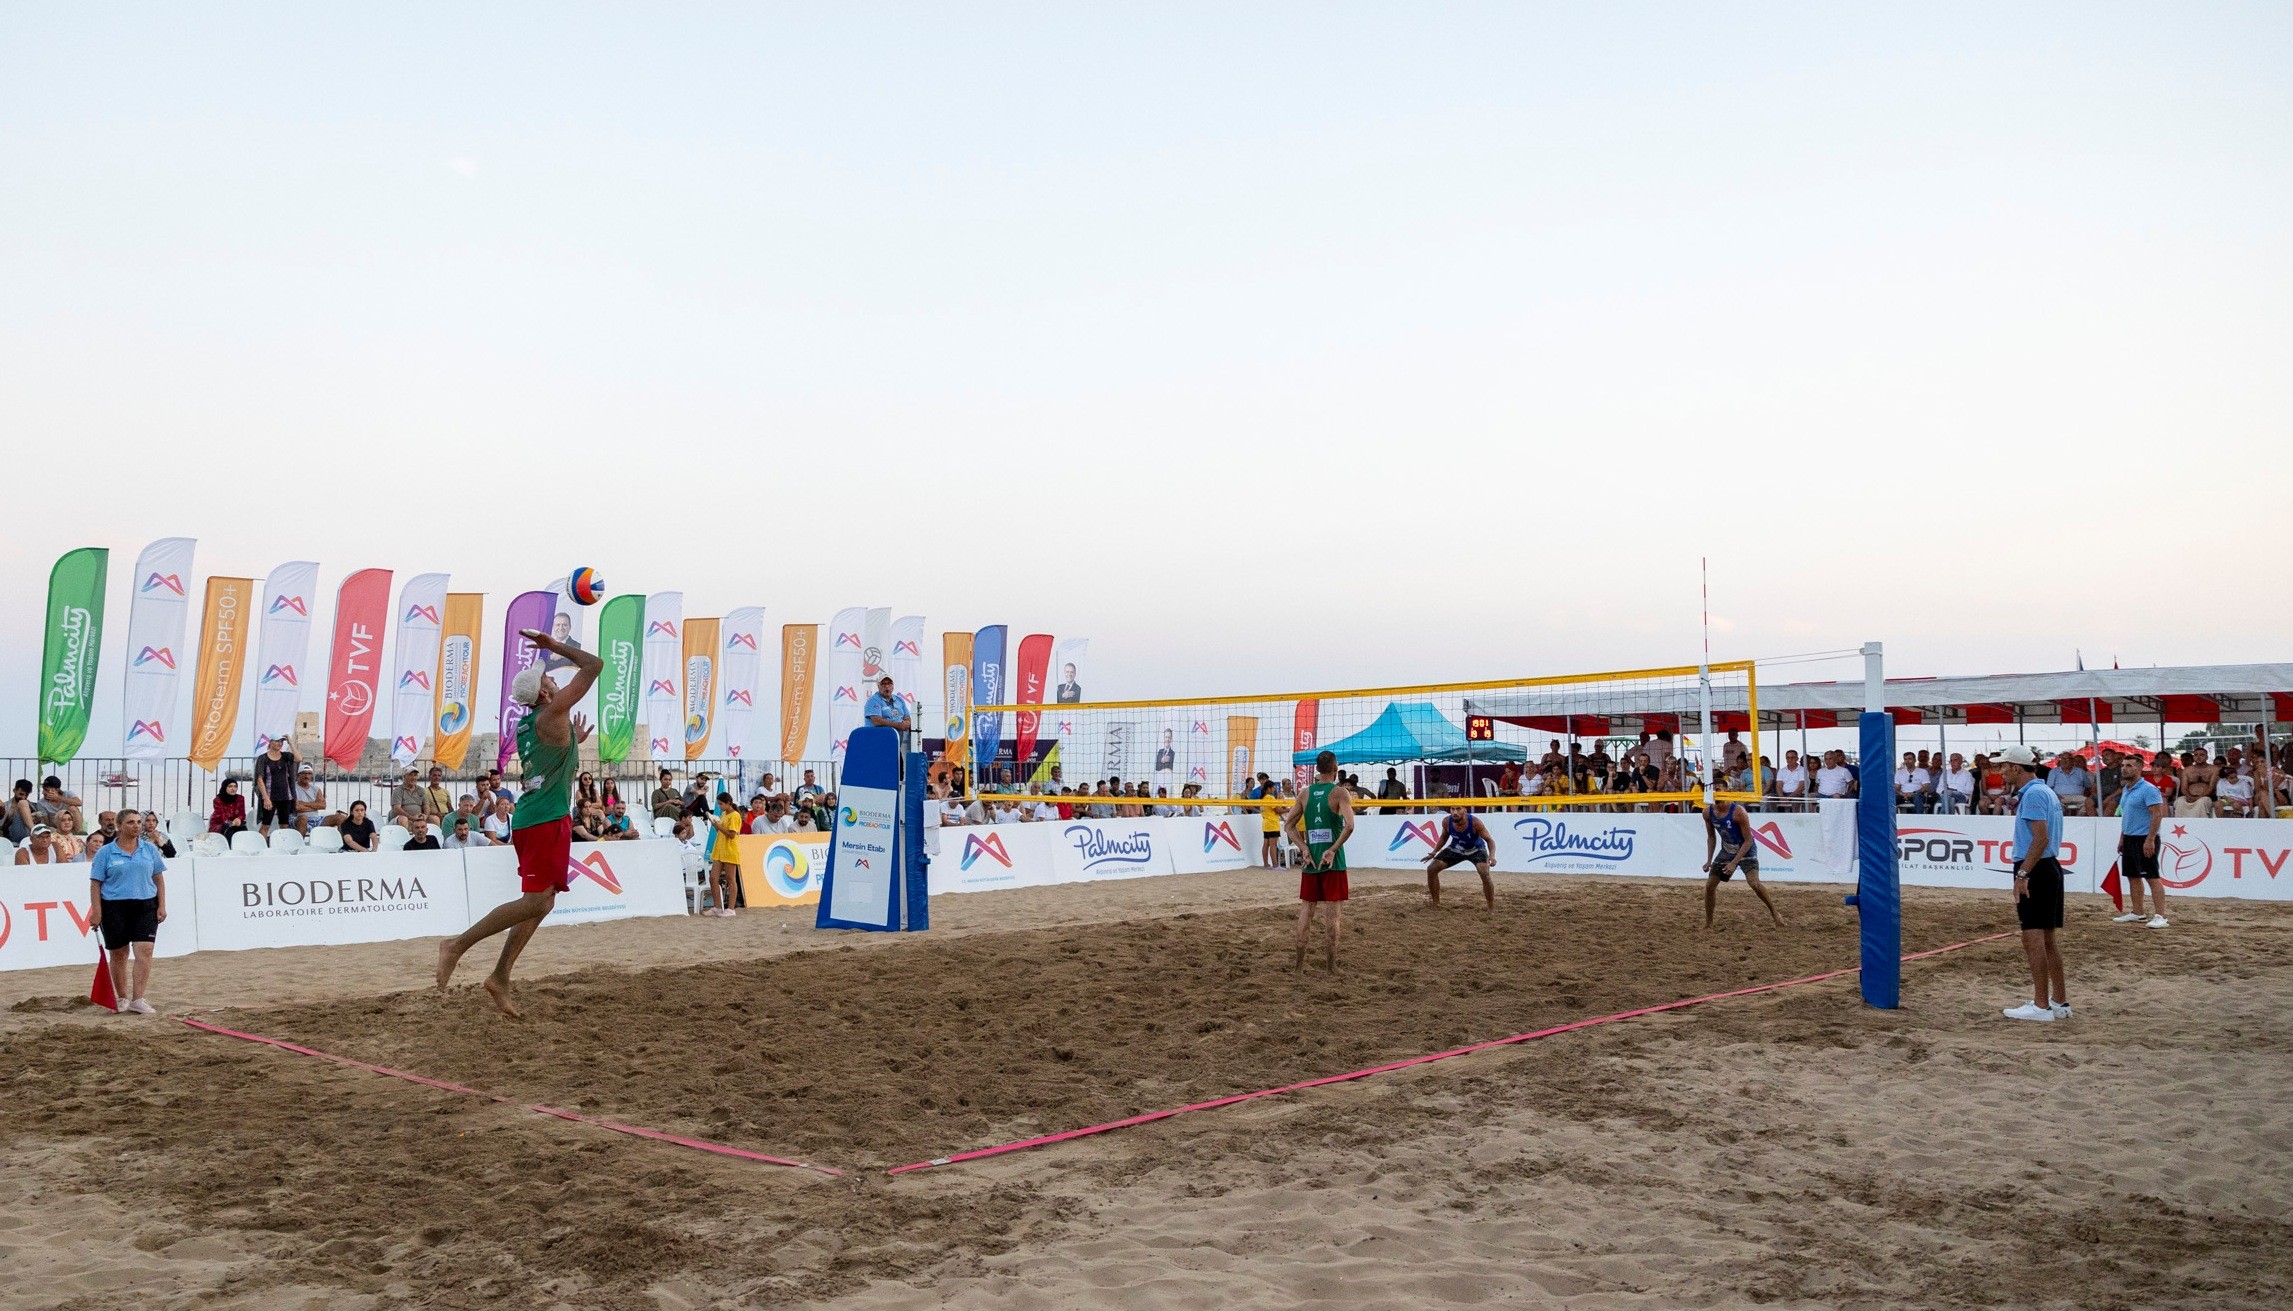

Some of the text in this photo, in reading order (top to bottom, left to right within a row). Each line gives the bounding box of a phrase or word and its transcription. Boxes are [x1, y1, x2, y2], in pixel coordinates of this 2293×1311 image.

[216, 584, 236, 653] SPF50+
[47, 605, 91, 725] Palmcity
[347, 622, 373, 674] TVF
[445, 642, 454, 699] BIODERMA
[793, 629, 806, 682] SPF50+
[602, 639, 634, 735] Palmcity
[859, 810, 891, 819] BIODERMA
[1316, 802, 1321, 813] 1
[1726, 820, 1732, 829] 2
[842, 841, 866, 851] Mersin
[1064, 825, 1151, 871] Palmcity
[1513, 818, 1636, 862] Palmcity
[242, 876, 427, 907] BIODERMA
[243, 902, 430, 919] LABORATOIRE DERMATOLOGIQUE
